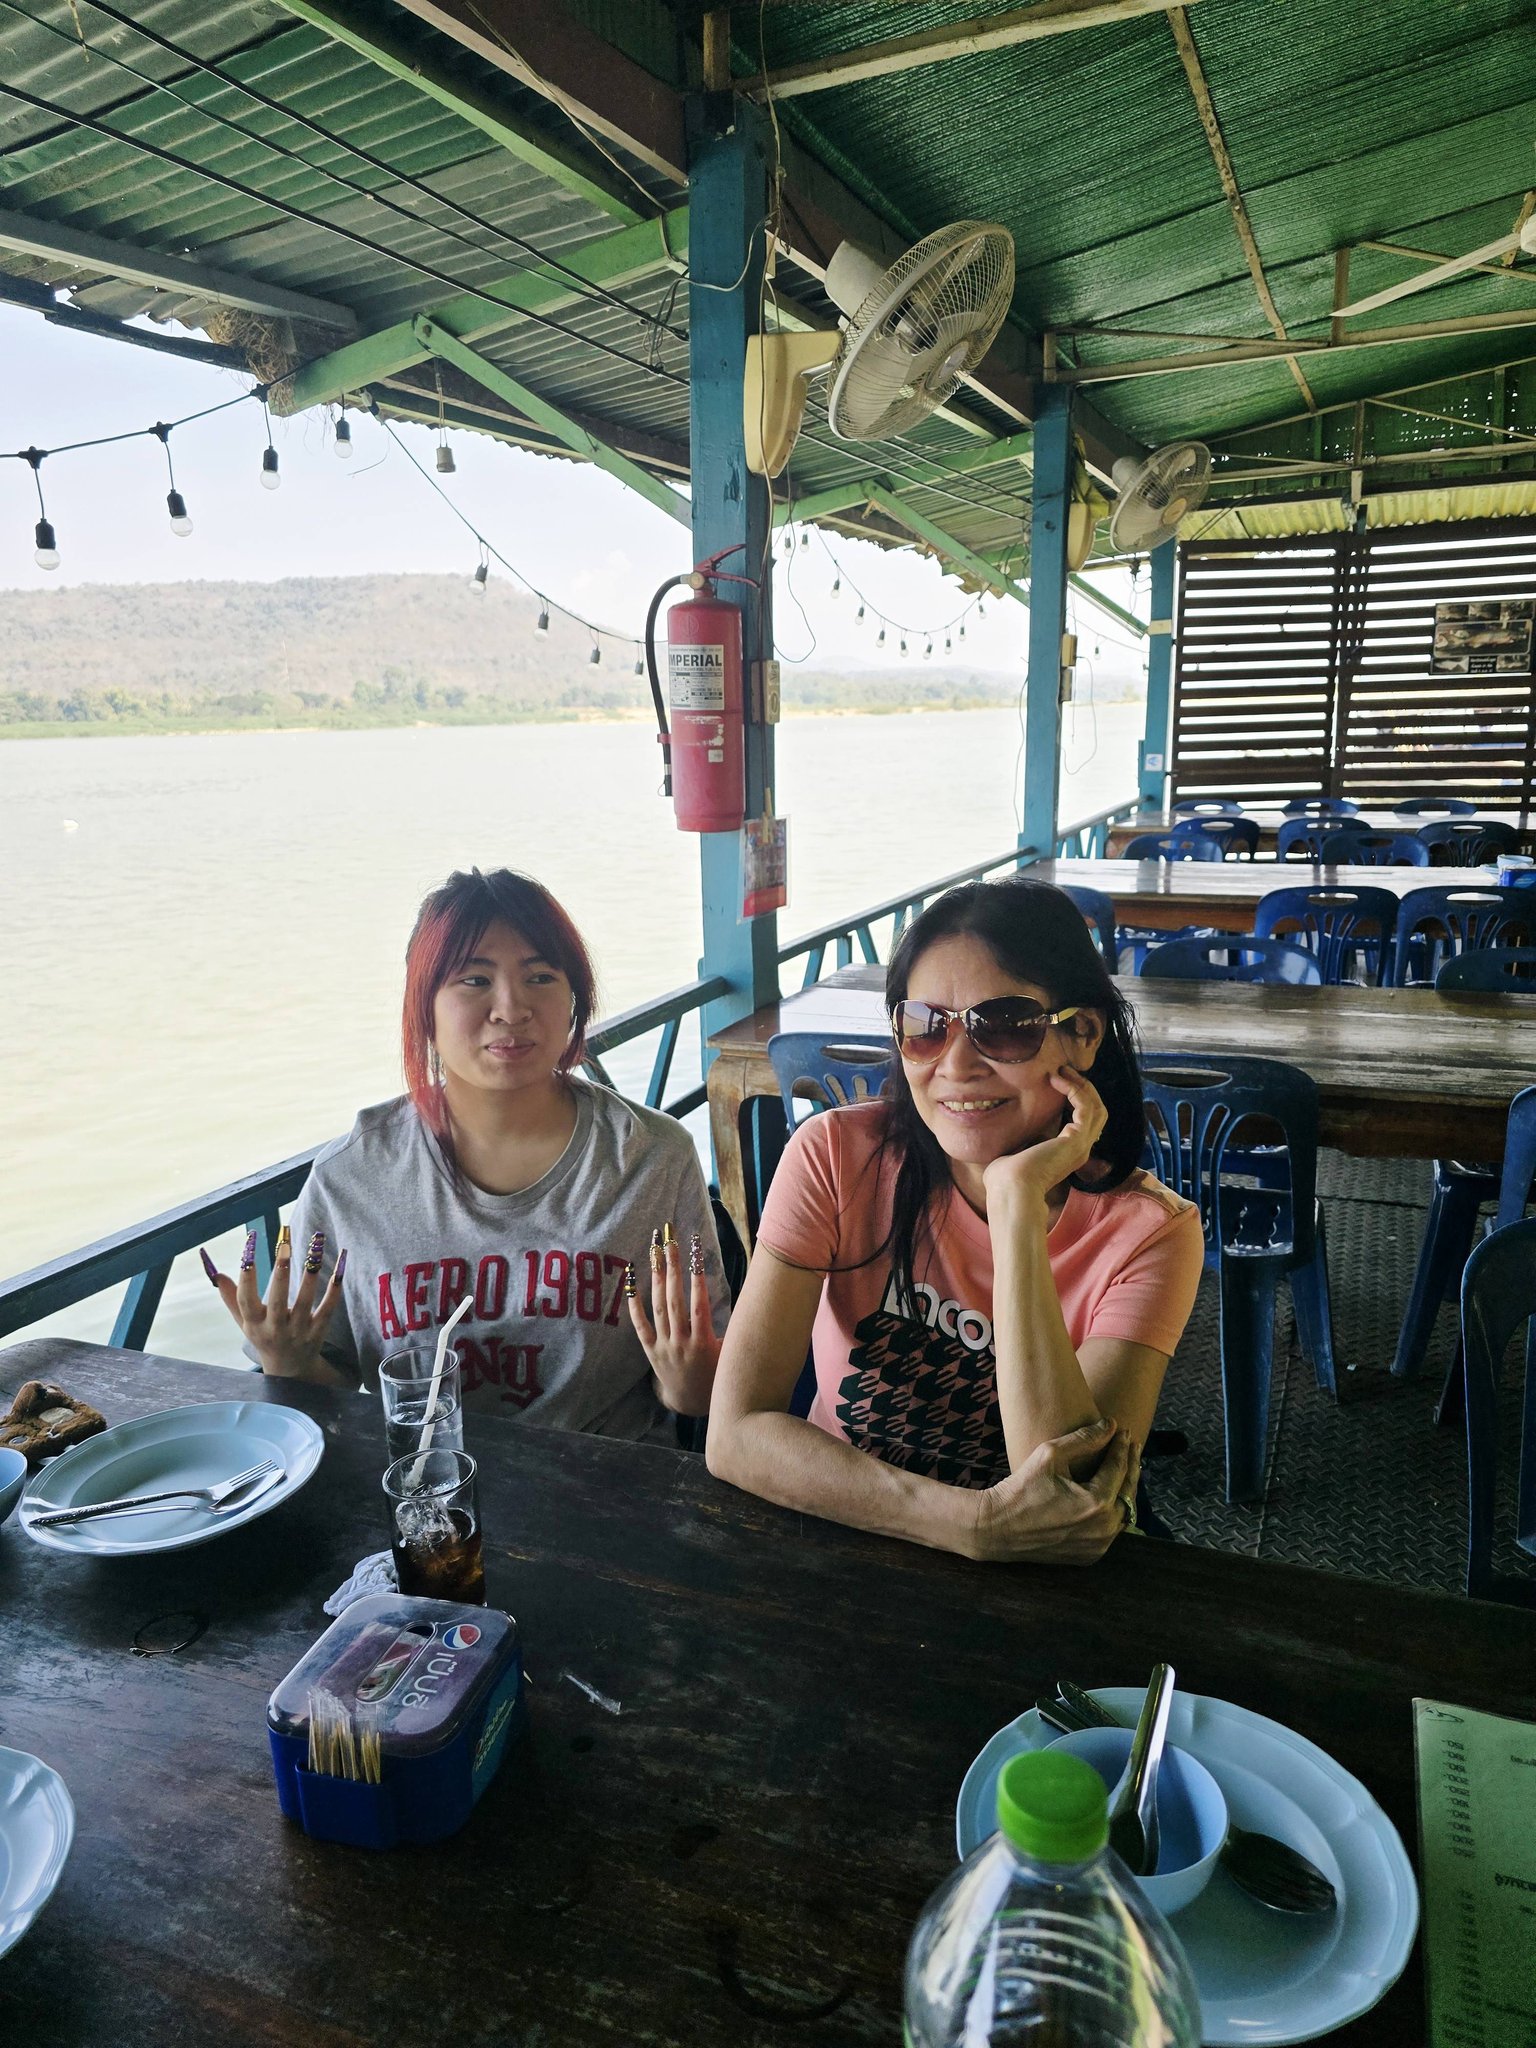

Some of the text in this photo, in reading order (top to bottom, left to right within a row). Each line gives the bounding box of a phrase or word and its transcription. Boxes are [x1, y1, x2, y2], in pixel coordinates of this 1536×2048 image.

[669, 654, 722, 667] MPERIAL
[378, 1249, 632, 1340] AERO 1987
[884, 1268, 996, 1357] LACO
